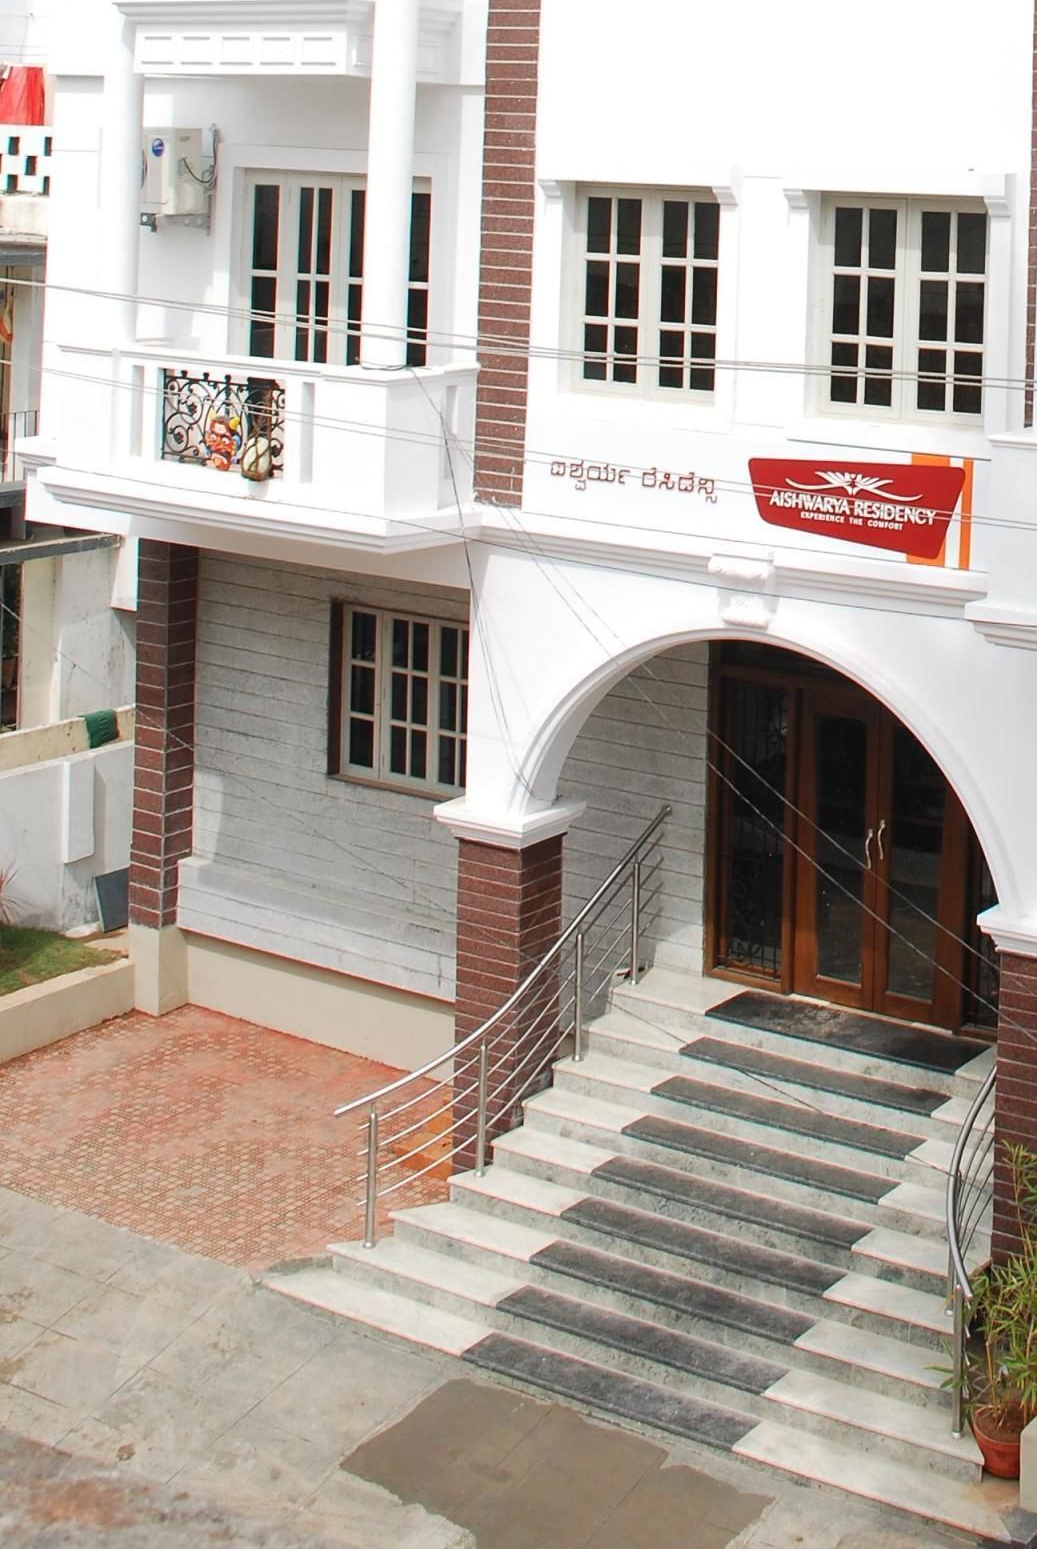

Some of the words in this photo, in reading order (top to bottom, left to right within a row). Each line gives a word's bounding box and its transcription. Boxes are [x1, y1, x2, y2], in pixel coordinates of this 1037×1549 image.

[550, 460, 631, 491] ಐಶ್ವರ್ಯ
[769, 490, 850, 515] AISHWARYA
[854, 500, 937, 526] RESIDENCY
[801, 511, 845, 524] EXPERIENCE
[850, 517, 863, 526] THE
[867, 520, 903, 531] COMFORT
